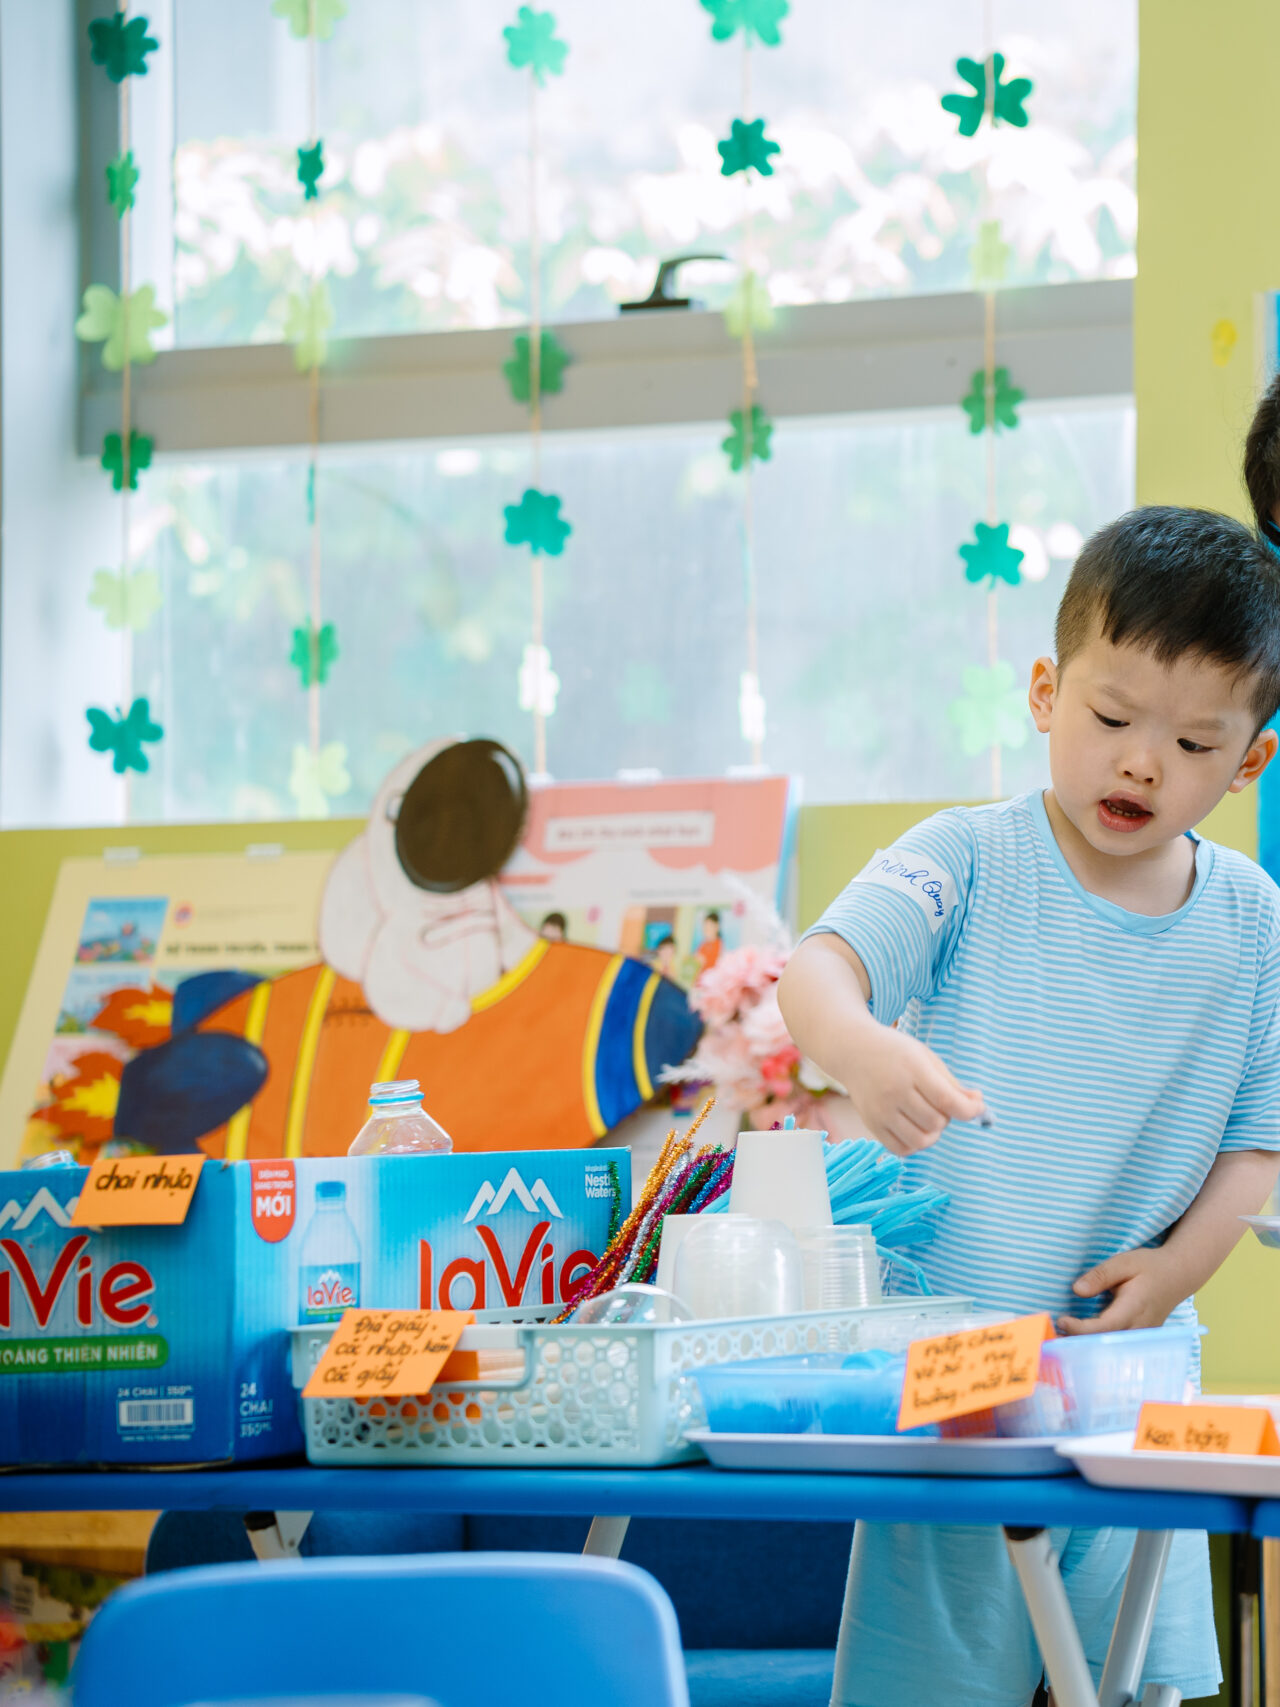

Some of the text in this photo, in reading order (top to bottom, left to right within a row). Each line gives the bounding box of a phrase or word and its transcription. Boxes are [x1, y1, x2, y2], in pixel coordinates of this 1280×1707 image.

[95, 1162, 139, 1191] chai
[585, 1173, 613, 1187] Nestl
[255, 1191, 292, 1218] MỚI
[307, 1280, 353, 1306] laVie
[53, 1344, 102, 1364] THIÊN
[107, 1341, 158, 1361] NHIÊN
[240, 1382, 257, 1399] 24
[239, 1400, 273, 1416] CHAI
